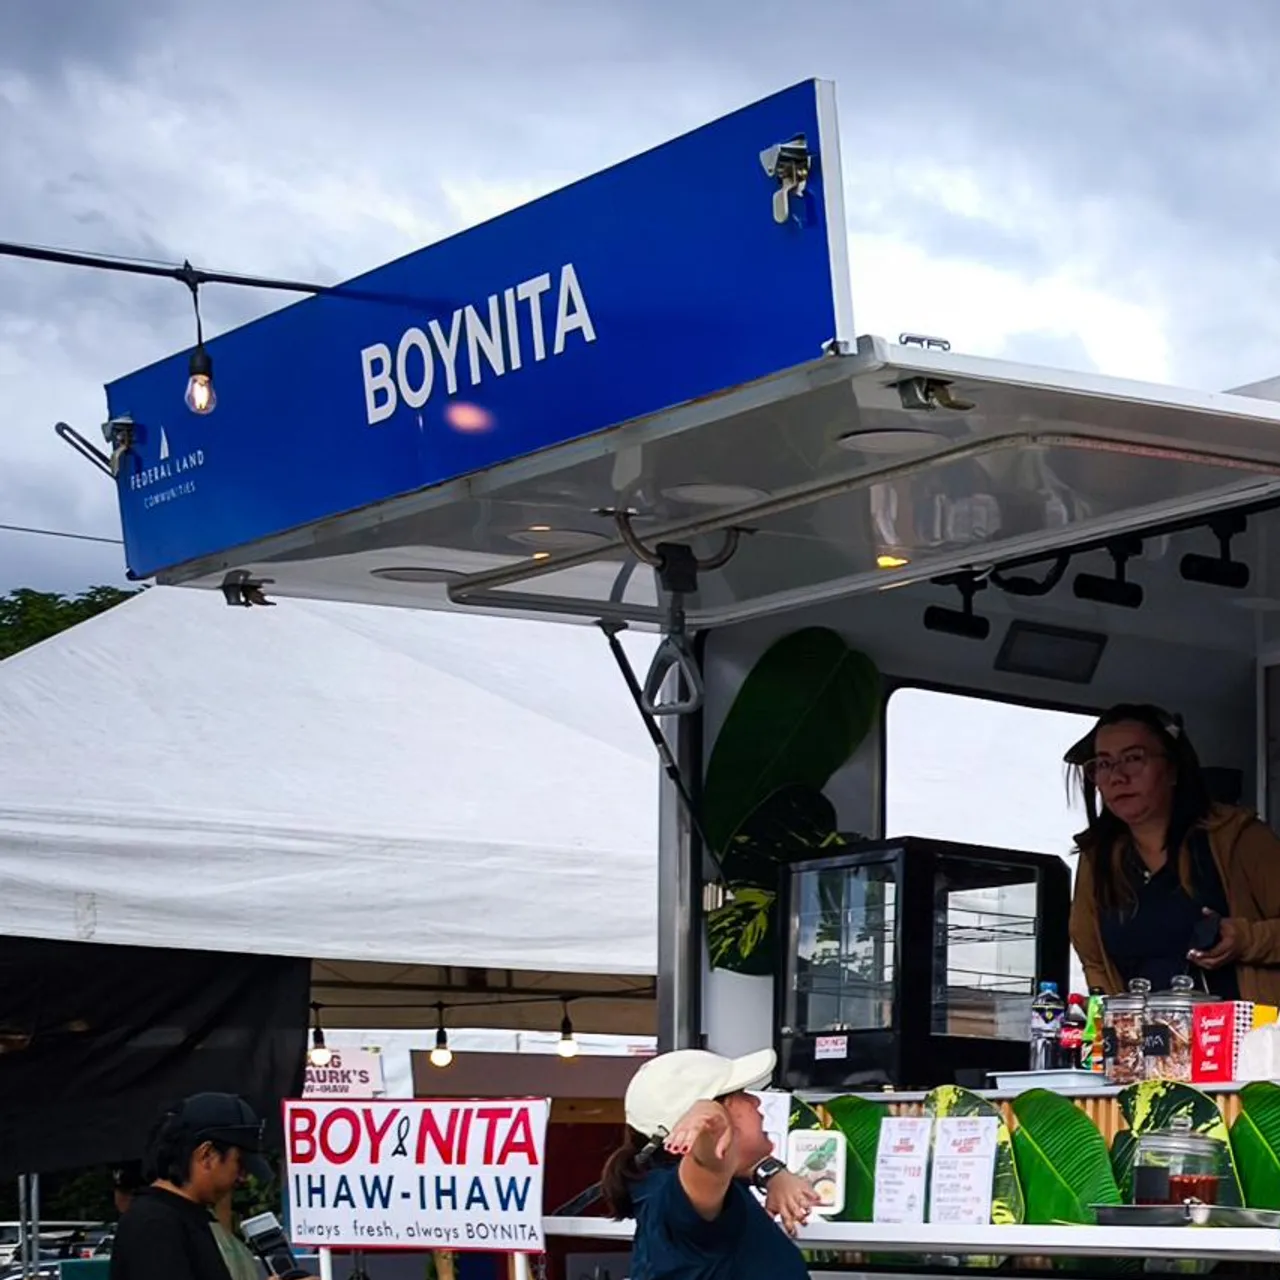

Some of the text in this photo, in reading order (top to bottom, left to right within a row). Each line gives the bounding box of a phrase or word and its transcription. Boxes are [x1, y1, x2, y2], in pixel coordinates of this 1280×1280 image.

[361, 263, 597, 425] BOYNITA
[175, 449, 205, 474] LAND
[295, 1174, 532, 1212] IHAW-IHAW
[296, 1219, 539, 1242] always fresh, always BOYNITA
